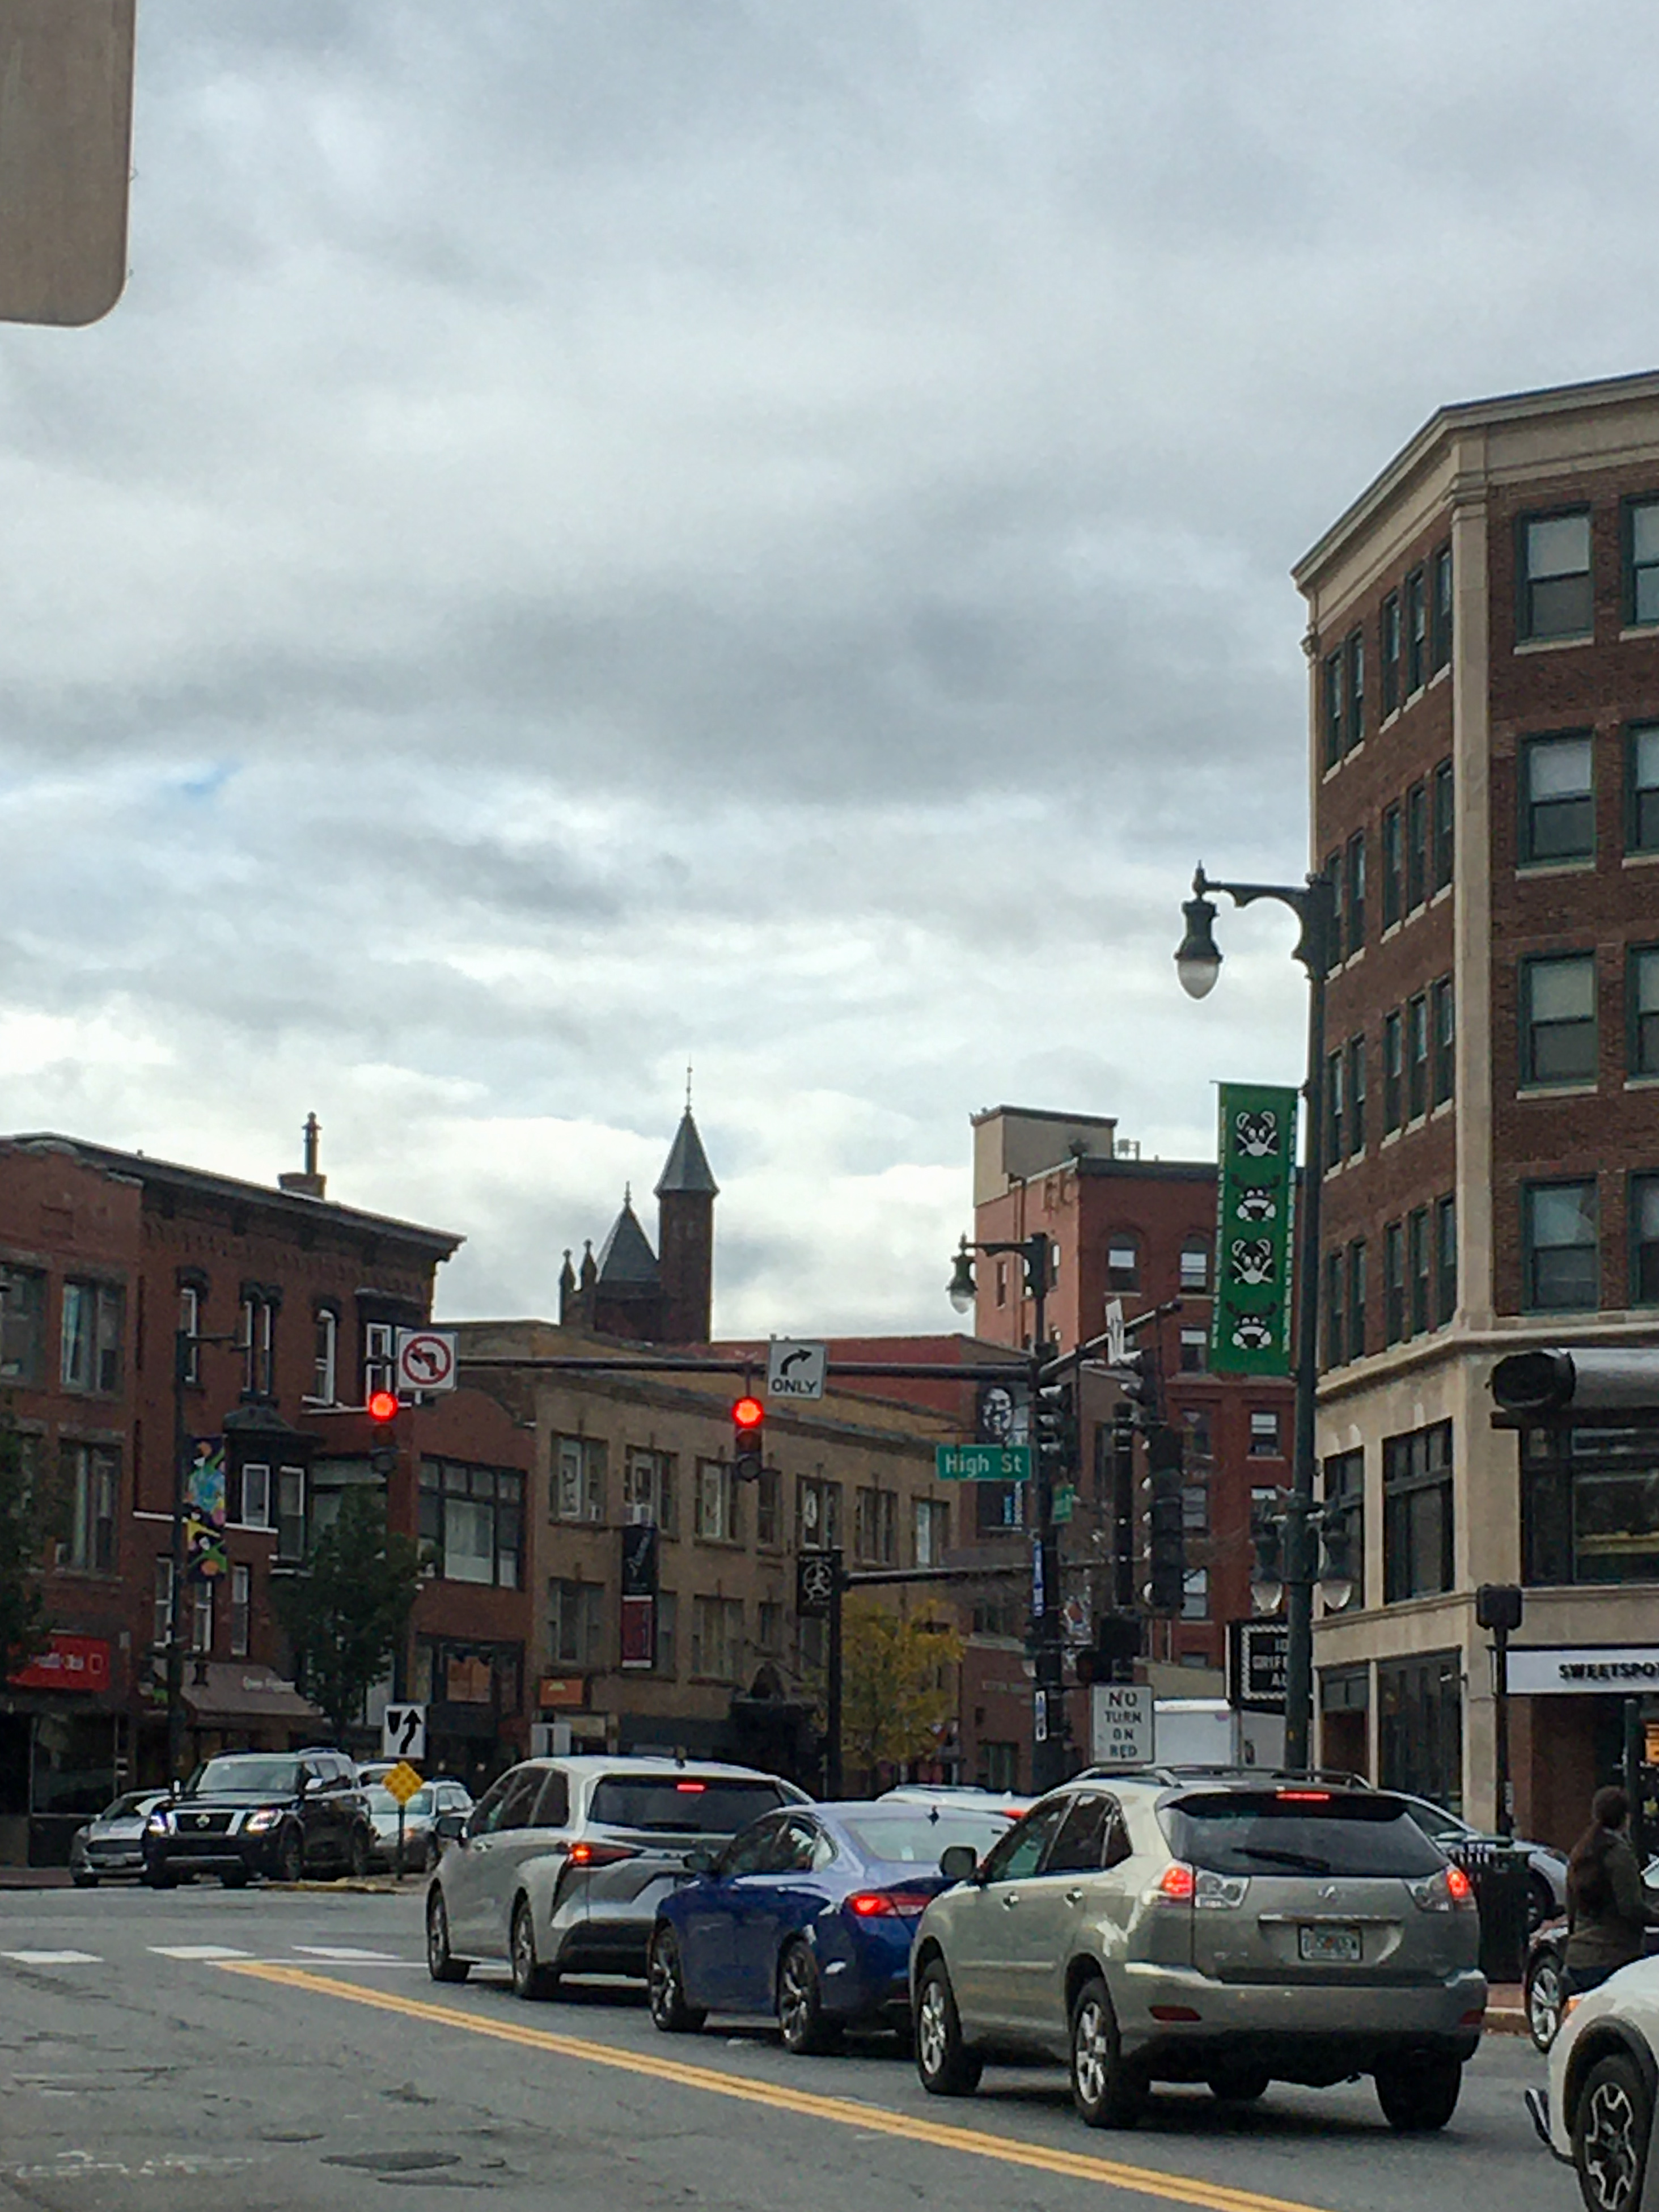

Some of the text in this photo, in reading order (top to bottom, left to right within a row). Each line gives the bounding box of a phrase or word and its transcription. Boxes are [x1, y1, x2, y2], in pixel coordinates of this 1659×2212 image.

[772, 1378, 818, 1394] ONLY
[945, 1452, 1023, 1479] High St
[1559, 1661, 1659, 1680] SWEETSPO
[1109, 1691, 1137, 1707] NO
[1104, 1710, 1142, 1724] TURN
[1112, 1727, 1133, 1741] ON
[1110, 1744, 1137, 1758] RED
